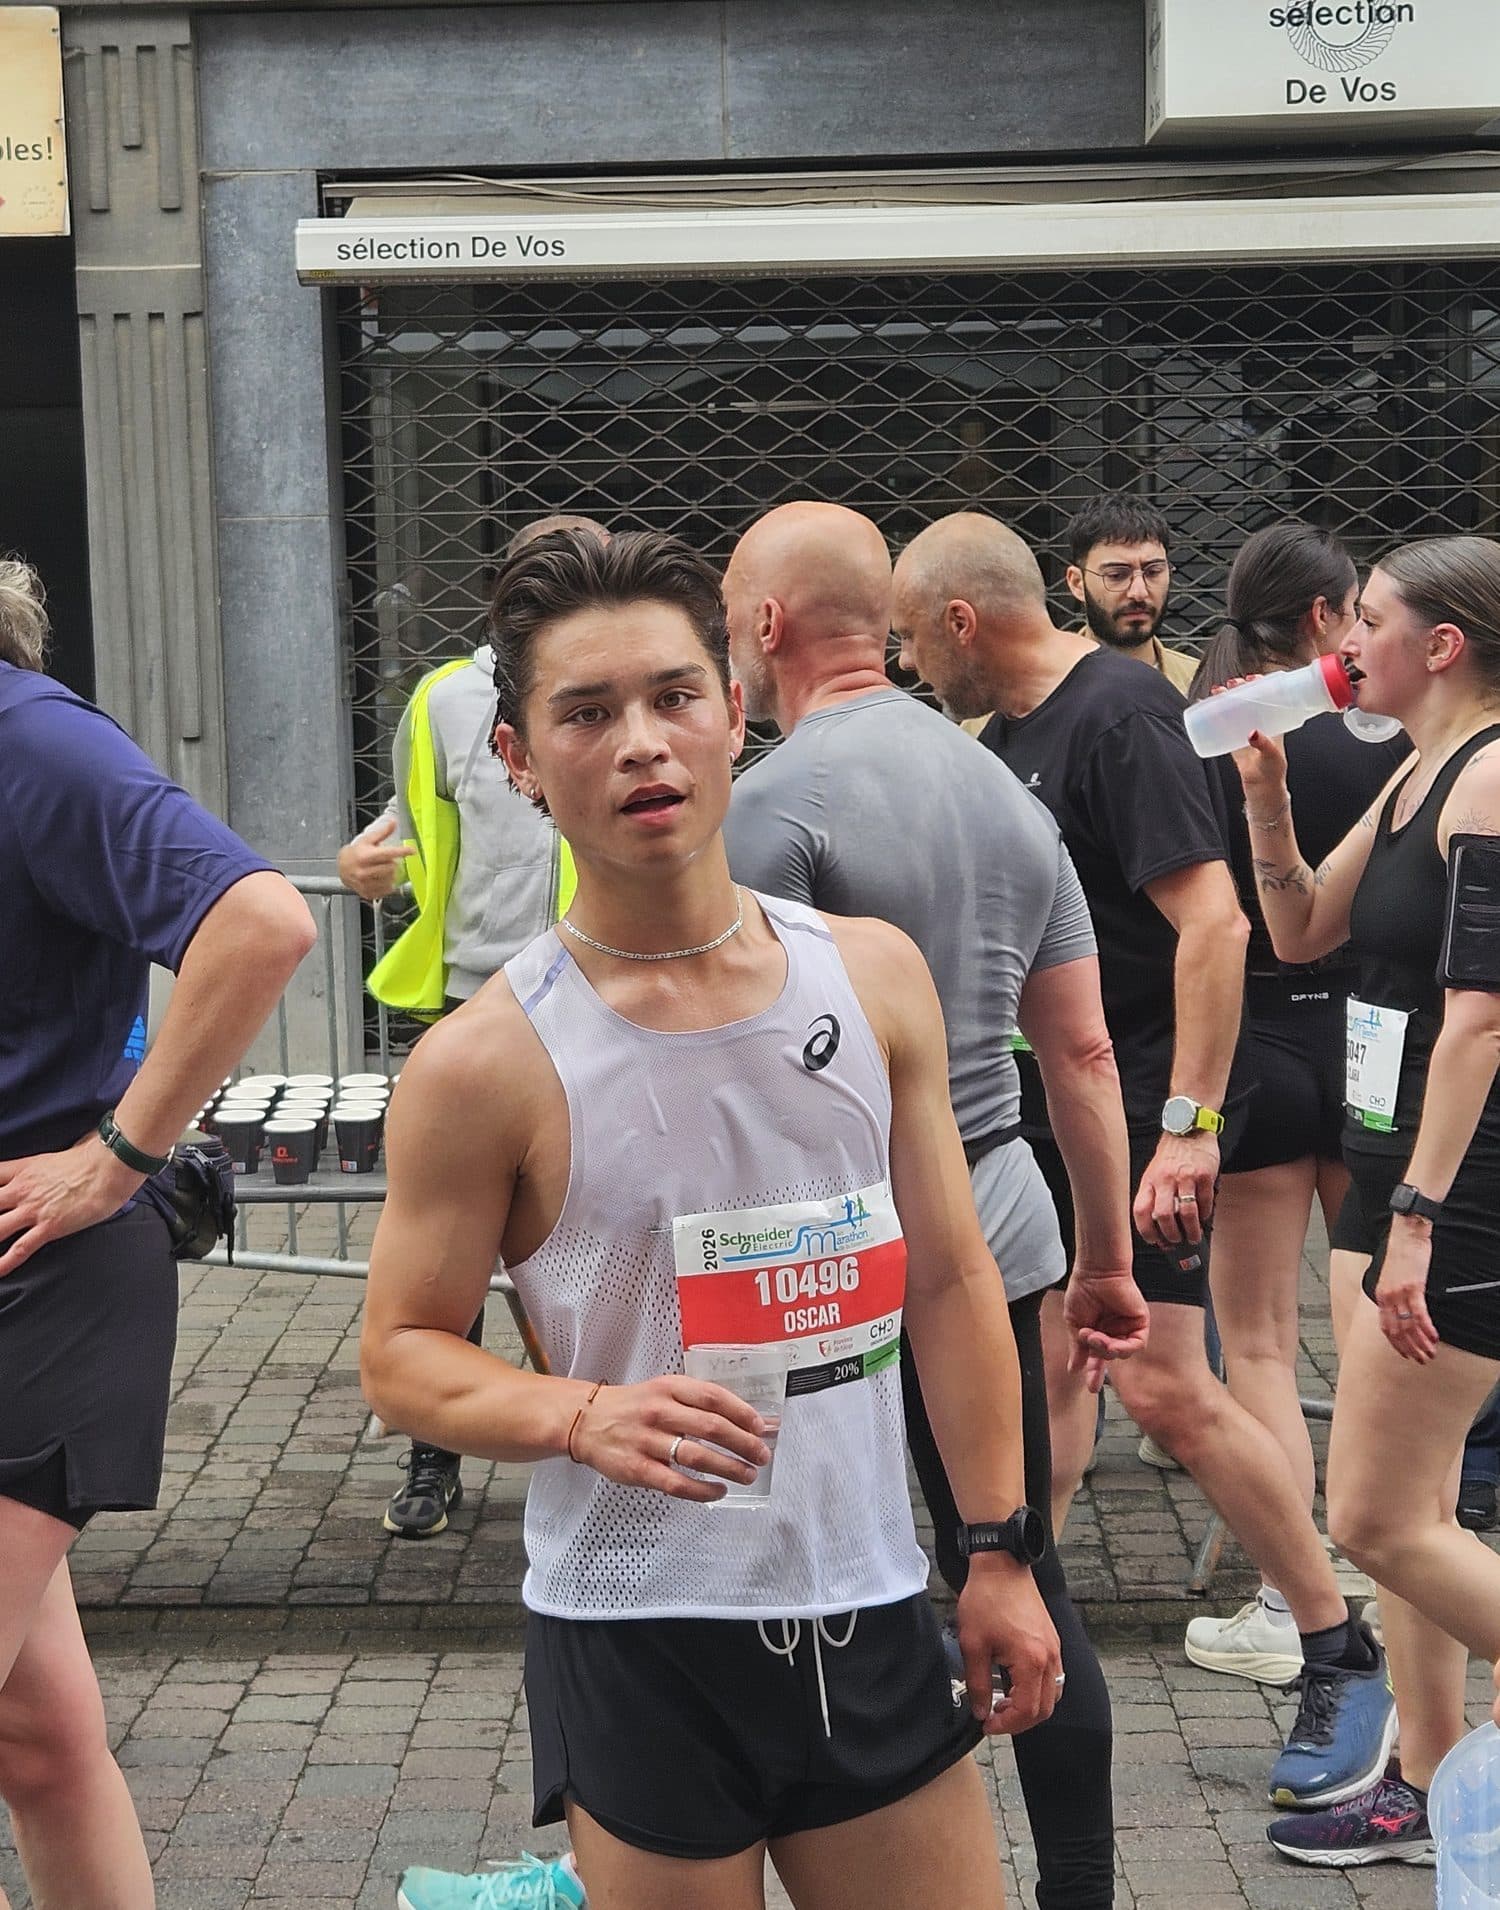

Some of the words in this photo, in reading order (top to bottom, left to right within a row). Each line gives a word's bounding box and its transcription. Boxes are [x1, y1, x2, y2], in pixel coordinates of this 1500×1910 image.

[1269, 0, 1414, 27] sélection
[1286, 79, 1327, 104] De
[1340, 77, 1397, 102] Vos
[337, 237, 460, 261] sélection
[471, 236, 507, 258] De
[516, 235, 565, 257] Vos
[701, 1228, 719, 1270] 2026
[719, 1227, 794, 1247] Schneider
[752, 1239, 794, 1252] Electric
[755, 1256, 860, 1306] 10496
[783, 1302, 841, 1333] OSCAR
[834, 1361, 860, 1381] 20%
